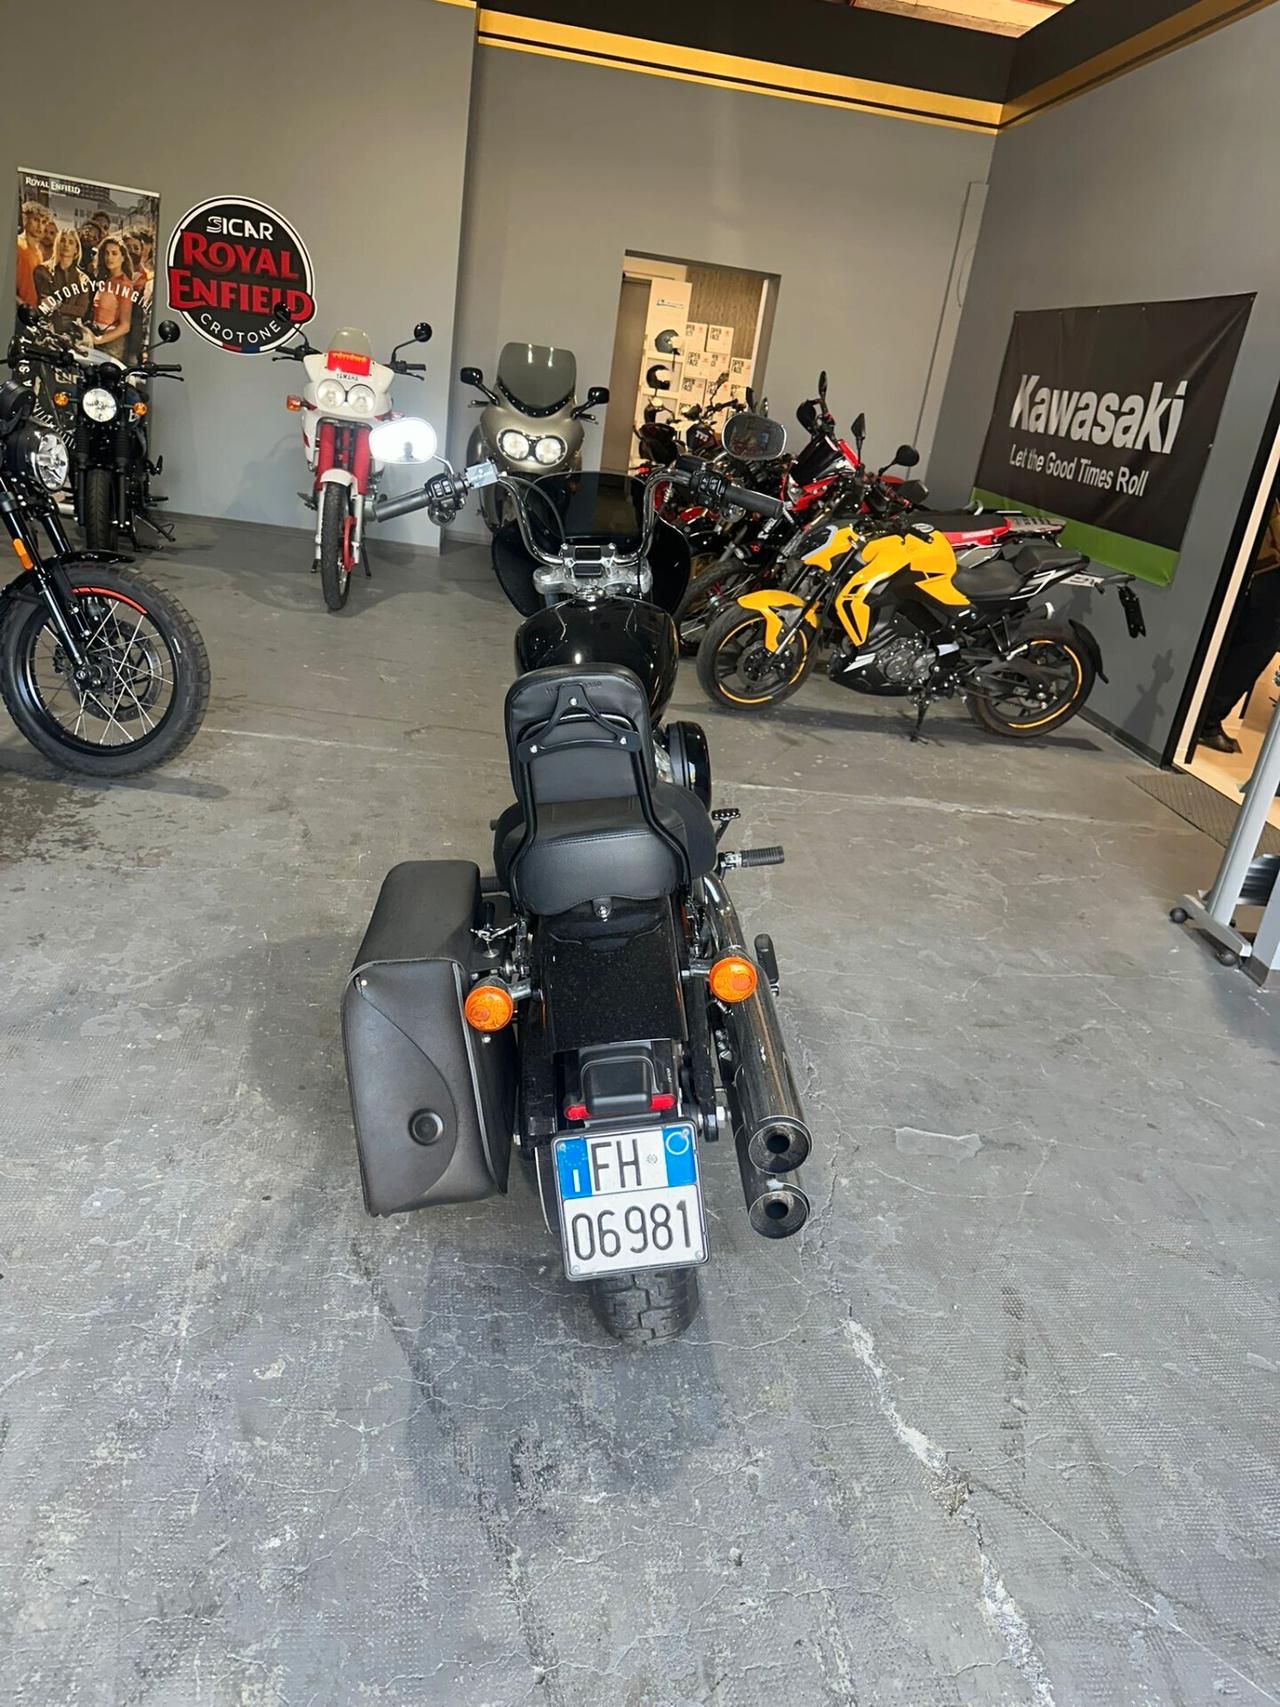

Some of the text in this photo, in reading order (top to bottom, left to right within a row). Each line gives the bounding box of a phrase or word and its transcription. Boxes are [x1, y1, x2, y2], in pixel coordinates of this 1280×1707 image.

[25, 176, 50, 188] ROYAL
[51, 181, 80, 195] ENFIELD
[206, 216, 274, 241] SICAR
[181, 231, 299, 280] ROYAL
[38, 280, 140, 315] MOTORCYCLING
[200, 313, 282, 343] CROTONE
[1009, 374, 1188, 454] Kawasaki
[1010, 444, 1150, 496] Let the Good Times Roll
[590, 1138, 643, 1191] FH
[571, 1200, 691, 1261] 06981
